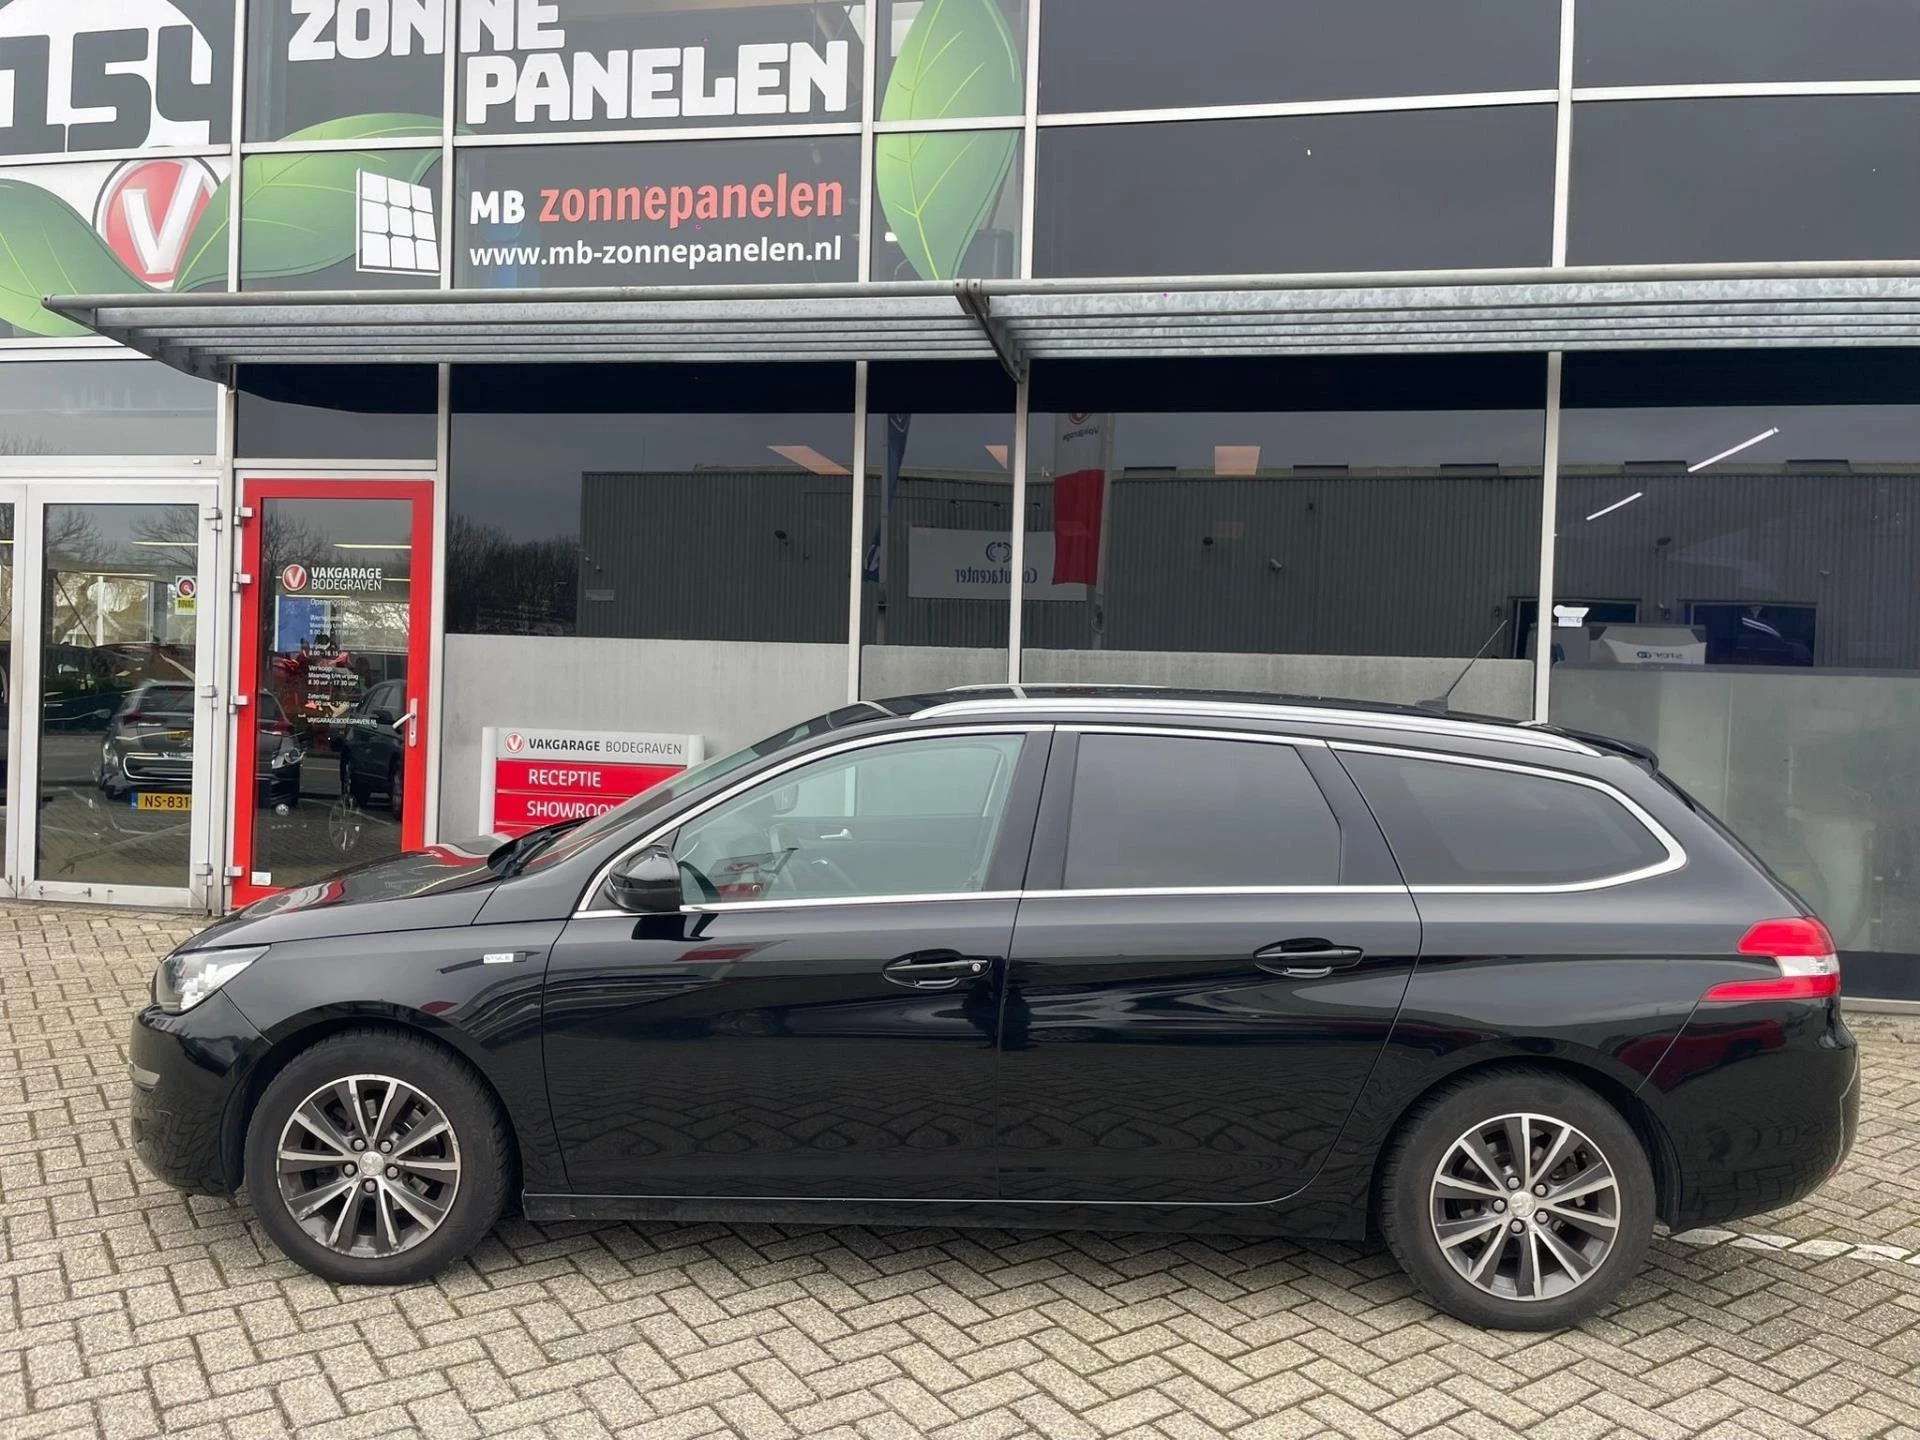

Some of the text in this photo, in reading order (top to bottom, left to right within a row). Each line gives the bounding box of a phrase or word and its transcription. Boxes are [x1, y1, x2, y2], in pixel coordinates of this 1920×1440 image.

[288, 0, 565, 61] ZONNE
[466, 40, 848, 125] PANELEN
[470, 172, 843, 229] MB zonnepanelen
[469, 235, 842, 270] www.mb-zonnepanelen.nl
[311, 567, 382, 580] VAKGARAGE
[311, 578, 382, 591] BODEGRAVEN
[308, 664, 332, 673] Verkoop
[308, 672, 331, 680] Maandag
[529, 738, 600, 751] VAKGARAGE
[605, 741, 682, 755] BODEGRAVEN
[528, 769, 601, 787] RECEPTIE
